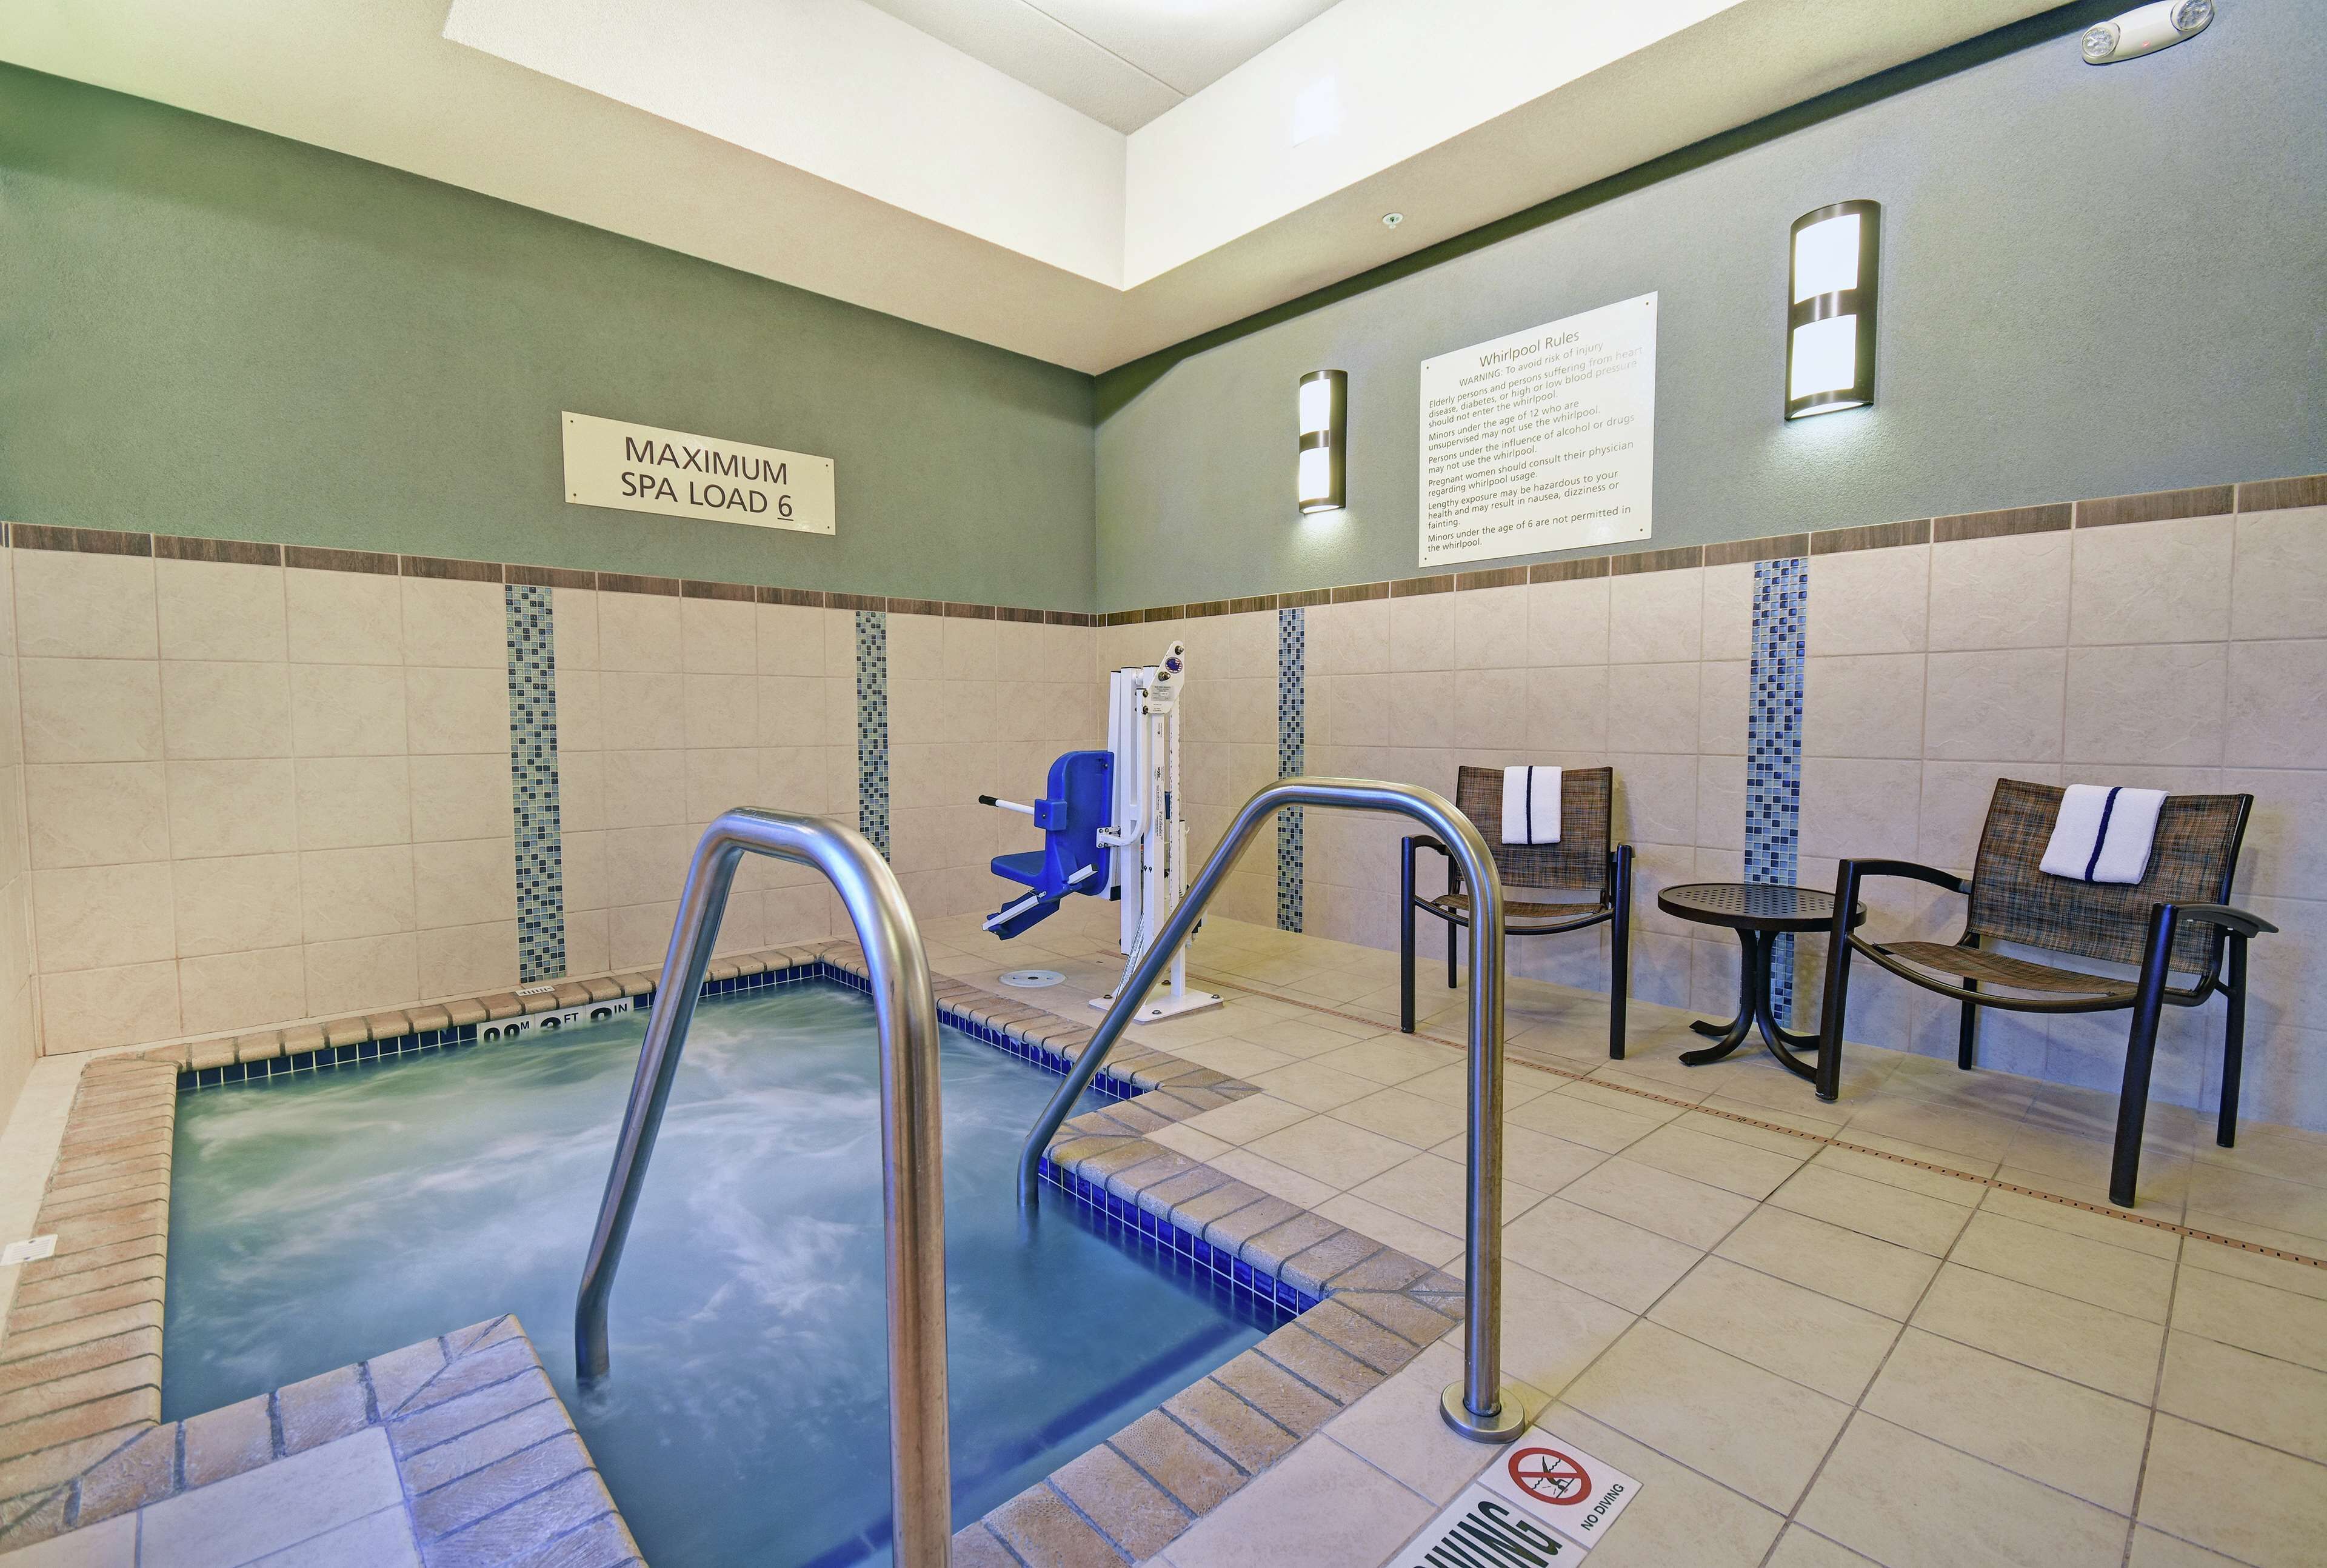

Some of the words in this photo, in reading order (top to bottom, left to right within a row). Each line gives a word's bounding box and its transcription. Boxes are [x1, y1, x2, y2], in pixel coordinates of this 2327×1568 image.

[1459, 369, 1503, 387] WARNING:
[1505, 365, 1515, 374] To
[1518, 356, 1542, 372] avoid
[1544, 352, 1560, 364] risk
[1563, 347, 1574, 359] of
[1576, 342, 1603, 356] injury
[1480, 339, 1540, 367] Whirlpool
[1545, 331, 1579, 350] Rules
[1429, 395, 1455, 409] Elderly
[1457, 387, 1488, 403] persons
[1490, 381, 1506, 393] and
[1508, 373, 1541, 390] persons
[1543, 362, 1586, 379] suffering
[1588, 355, 1612, 368] from
[1615, 346, 1643, 361] heart
[1429, 406, 1458, 418] disease,
[1460, 396, 1497, 410] diabetes,
[1499, 392, 1509, 401] or
[1511, 385, 1531, 398] high
[1533, 383, 1543, 392] or
[1545, 379, 1563, 389] low
[1564, 369, 1592, 384] blood
[1595, 360, 1637, 379] pressure
[1428, 414, 1454, 429] should
[1456, 412, 1470, 421] not
[1472, 407, 1494, 418] enter
[1496, 402, 1511, 412] the
[1513, 389, 1558, 408] whirlpool.
[1429, 430, 1455, 441] Minors
[1457, 423, 1481, 435] under
[1483, 419, 1497, 429] the
[1499, 416, 1515, 426] age
[1517, 410, 1527, 421] of
[1530, 408, 1539, 418] 12
[1541, 404, 1561, 415] who
[1564, 401, 1579, 410] are
[1429, 432, 1479, 451] unsupervised
[1481, 430, 1499, 439] may
[1501, 425, 1516, 435] not
[1518, 422, 1533, 432] use
[1535, 418, 1551, 427] the
[1552, 405, 1600, 424] whirlpool.
[1428, 453, 1457, 464] Persons
[1459, 447, 1483, 458] under
[1485, 443, 1499, 452] the
[1501, 435, 1541, 449] influence
[1544, 429, 1554, 440] of
[1556, 421, 1590, 437] alcohol
[1593, 421, 1604, 430] or
[1606, 415, 1635, 427] drugs
[1428, 465, 1444, 474] may
[1446, 461, 1460, 470] not
[1462, 459, 1475, 467] use
[1477, 455, 1491, 464] the
[1493, 445, 1537, 461] whirlpool.
[625, 436, 787, 485] MAXIMUM
[1428, 474, 1463, 487] Pregnant
[1465, 469, 1496, 480] women
[1498, 460, 1526, 474] should
[1529, 454, 1561, 468] consult
[1563, 450, 1586, 461] their
[1589, 441, 1634, 459] physician
[621, 472, 678, 502] SPA
[689, 481, 768, 513] LOAD
[778, 495, 793, 517] 6
[1428, 484, 1466, 498] regarding
[1468, 475, 1507, 490] whirlpool
[1510, 472, 1538, 482] usage.
[1428, 498, 1459, 510] Lengthy
[1461, 492, 1498, 505] exposure
[1500, 489, 1518, 498] may
[1520, 485, 1531, 494] be
[1534, 477, 1580, 492] hazardous
[1596, 470, 1618, 483] your
[1428, 509, 1452, 520] health
[1454, 505, 1469, 515] and
[1472, 504, 1489, 513] may
[1491, 498, 1515, 510] result
[1517, 496, 1525, 505] in
[1527, 492, 1561, 504] nausea,
[1564, 484, 1606, 498] dizziness
[1608, 481, 1620, 490] or
[1427, 533, 1454, 542] Minors
[1456, 528, 1480, 538] under
[1481, 525, 1496, 535] the
[1498, 524, 1514, 534] age
[1515, 520, 1526, 530] of
[1527, 519, 1533, 528] 6
[1552, 515, 1568, 524] not
[1571, 505, 1618, 524] permitted
[1427, 519, 1460, 529] fainting.
[1427, 544, 1440, 552] the
[1442, 537, 1482, 550] whirlpool.
[1580, 1514, 1598, 1531] NO
[1594, 1484, 1624, 1515] DIVING
